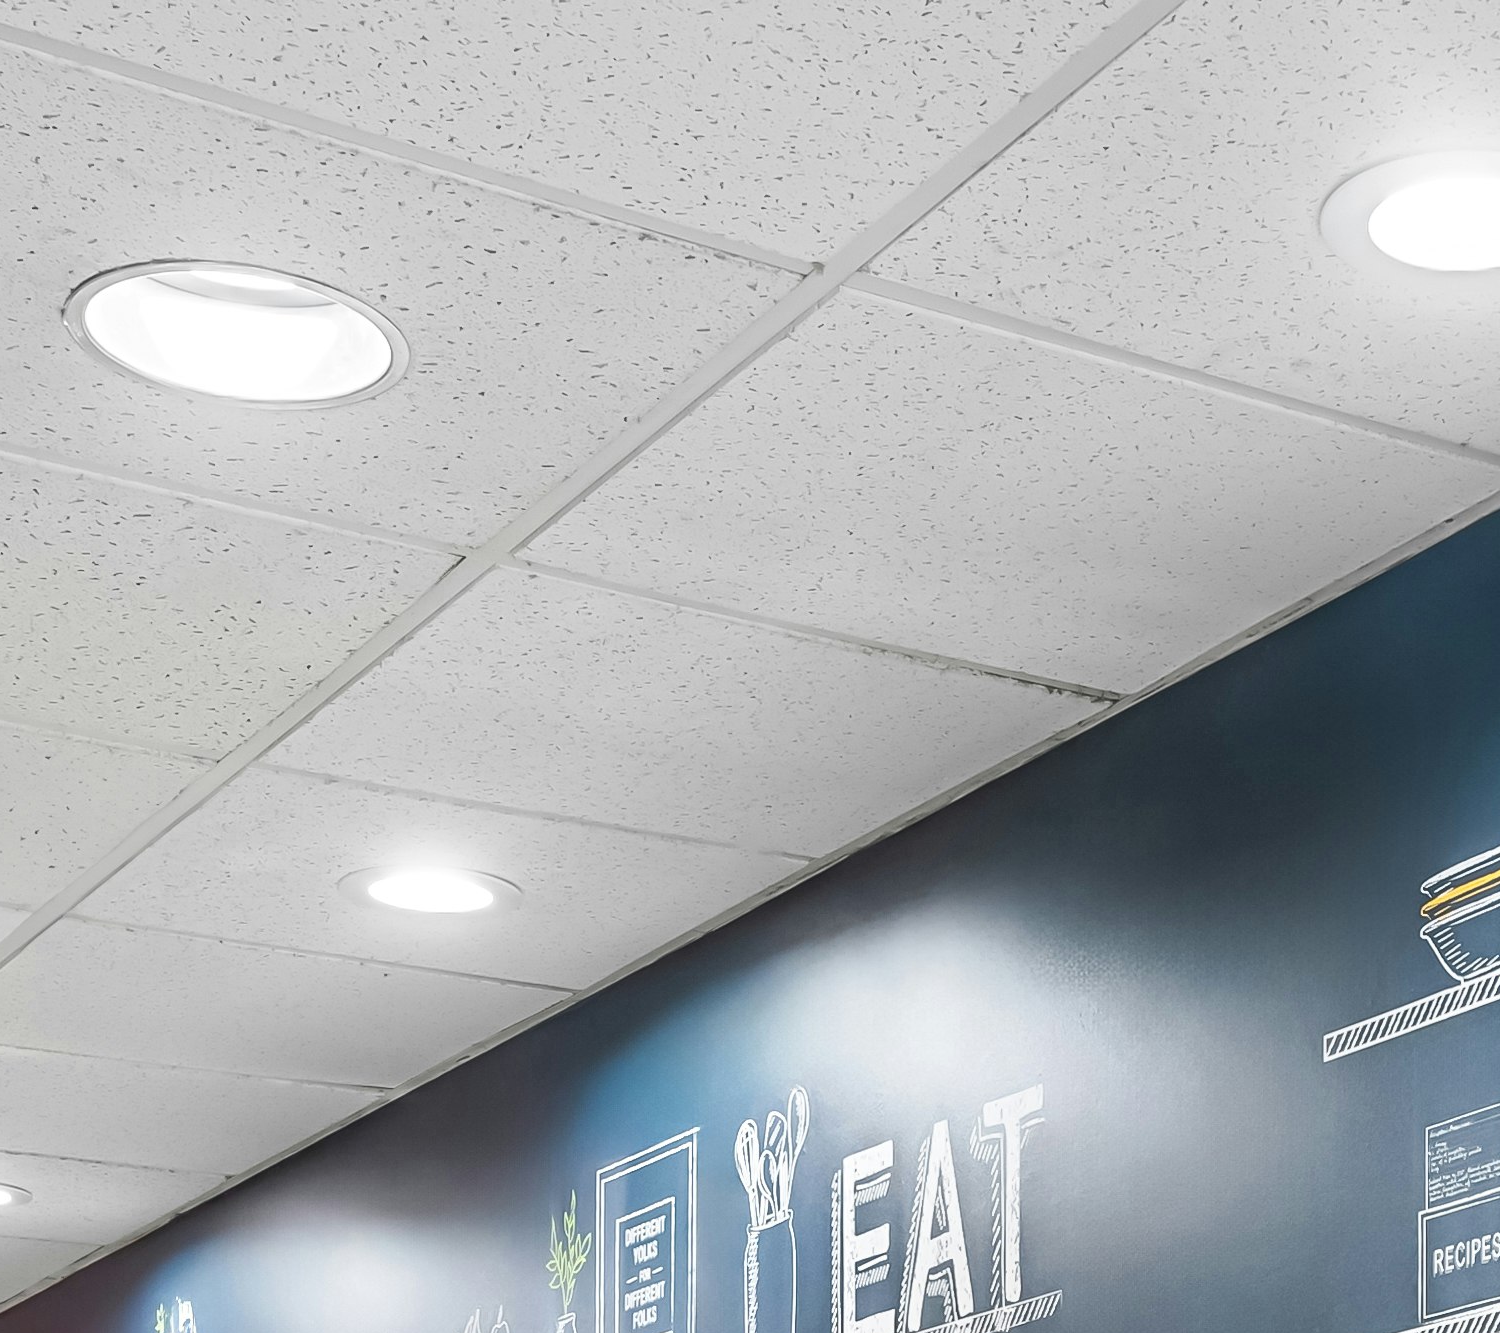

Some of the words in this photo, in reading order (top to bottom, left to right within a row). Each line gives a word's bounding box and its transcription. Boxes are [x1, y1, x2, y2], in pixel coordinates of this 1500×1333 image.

[624, 1215, 667, 1248] DIFFERENT
[632, 1240, 658, 1266] YOLKS
[638, 1267, 652, 1283] FOR
[624, 1280, 666, 1311] DIFFERENT
[632, 1305, 657, 1330] FOLKS
